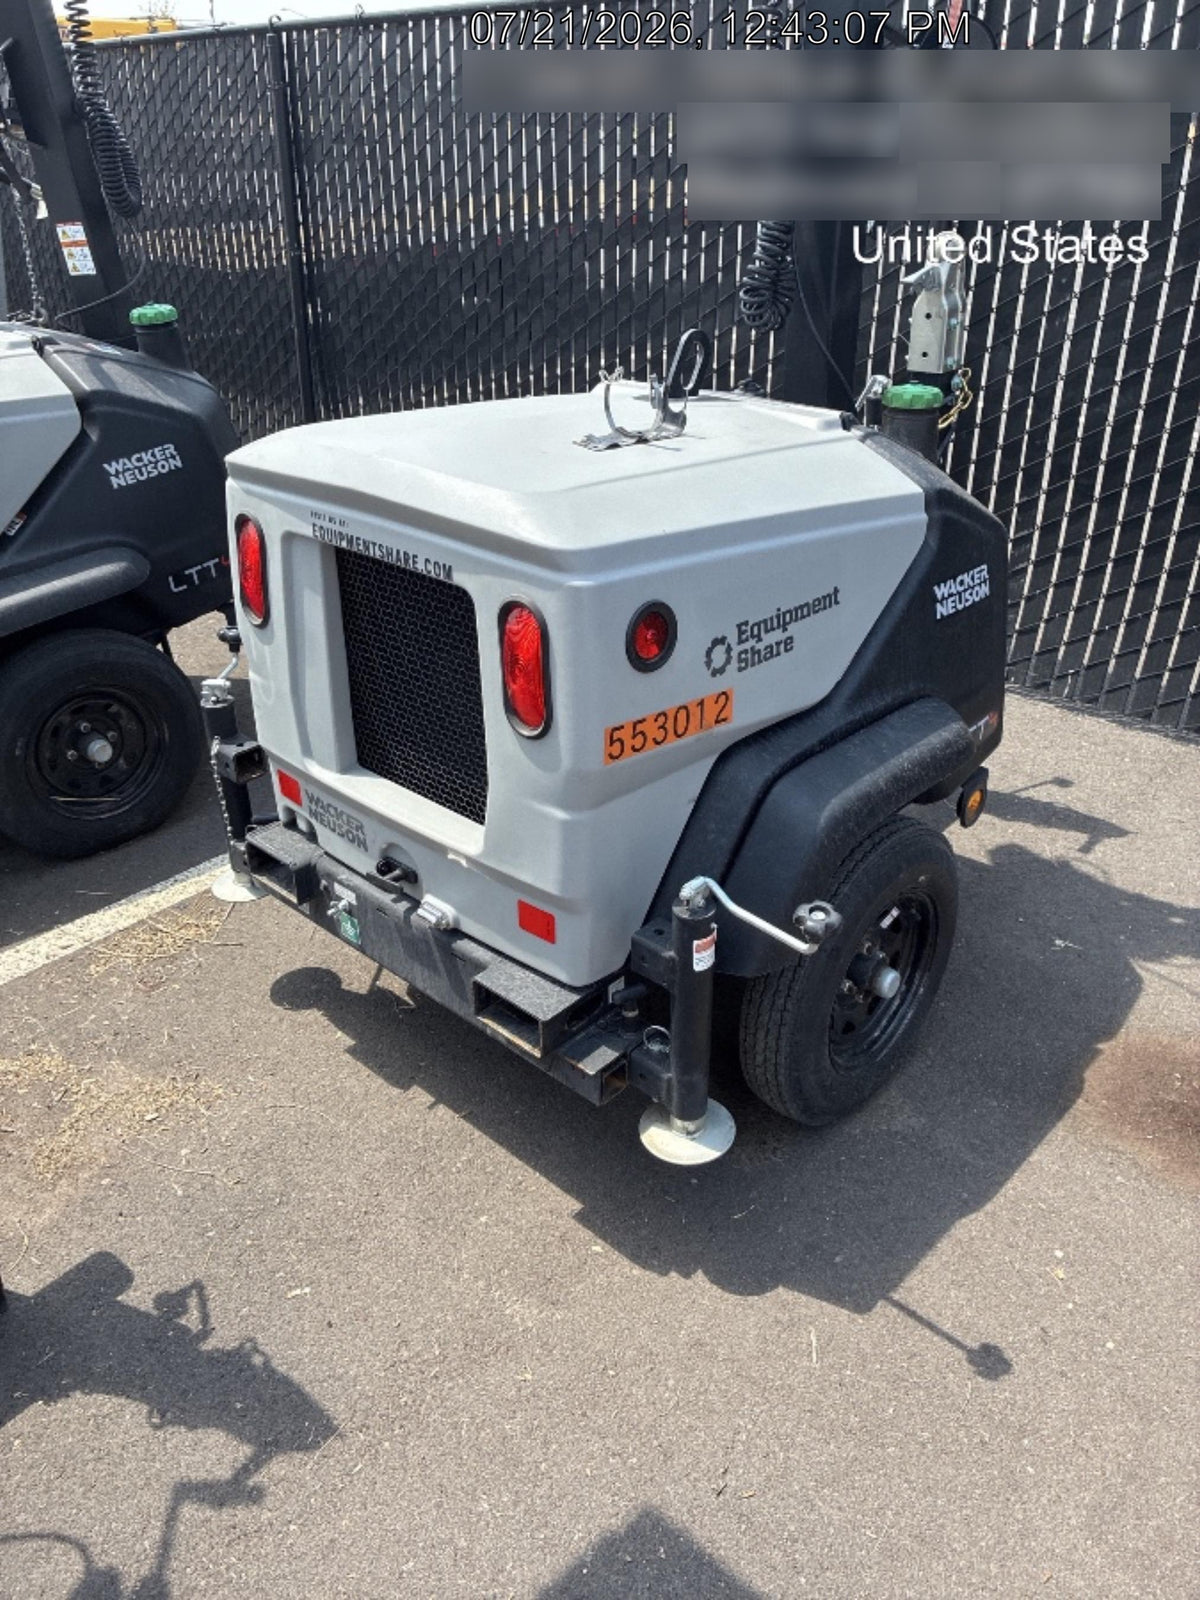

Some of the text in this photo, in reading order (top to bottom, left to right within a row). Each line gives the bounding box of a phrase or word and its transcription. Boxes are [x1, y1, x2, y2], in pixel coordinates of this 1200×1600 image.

[103, 443, 178, 475] WACKER
[110, 455, 183, 489] NEUSON
[312, 522, 455, 582] EQUIPMENTSHARE.COM
[933, 564, 989, 601] WACKER
[935, 580, 990, 620] NEUSON
[736, 586, 840, 646] Equipment
[737, 636, 794, 673] Share
[608, 691, 730, 760] 553012
[304, 788, 366, 837] WACKER
[308, 805, 368, 853] NEUSON
